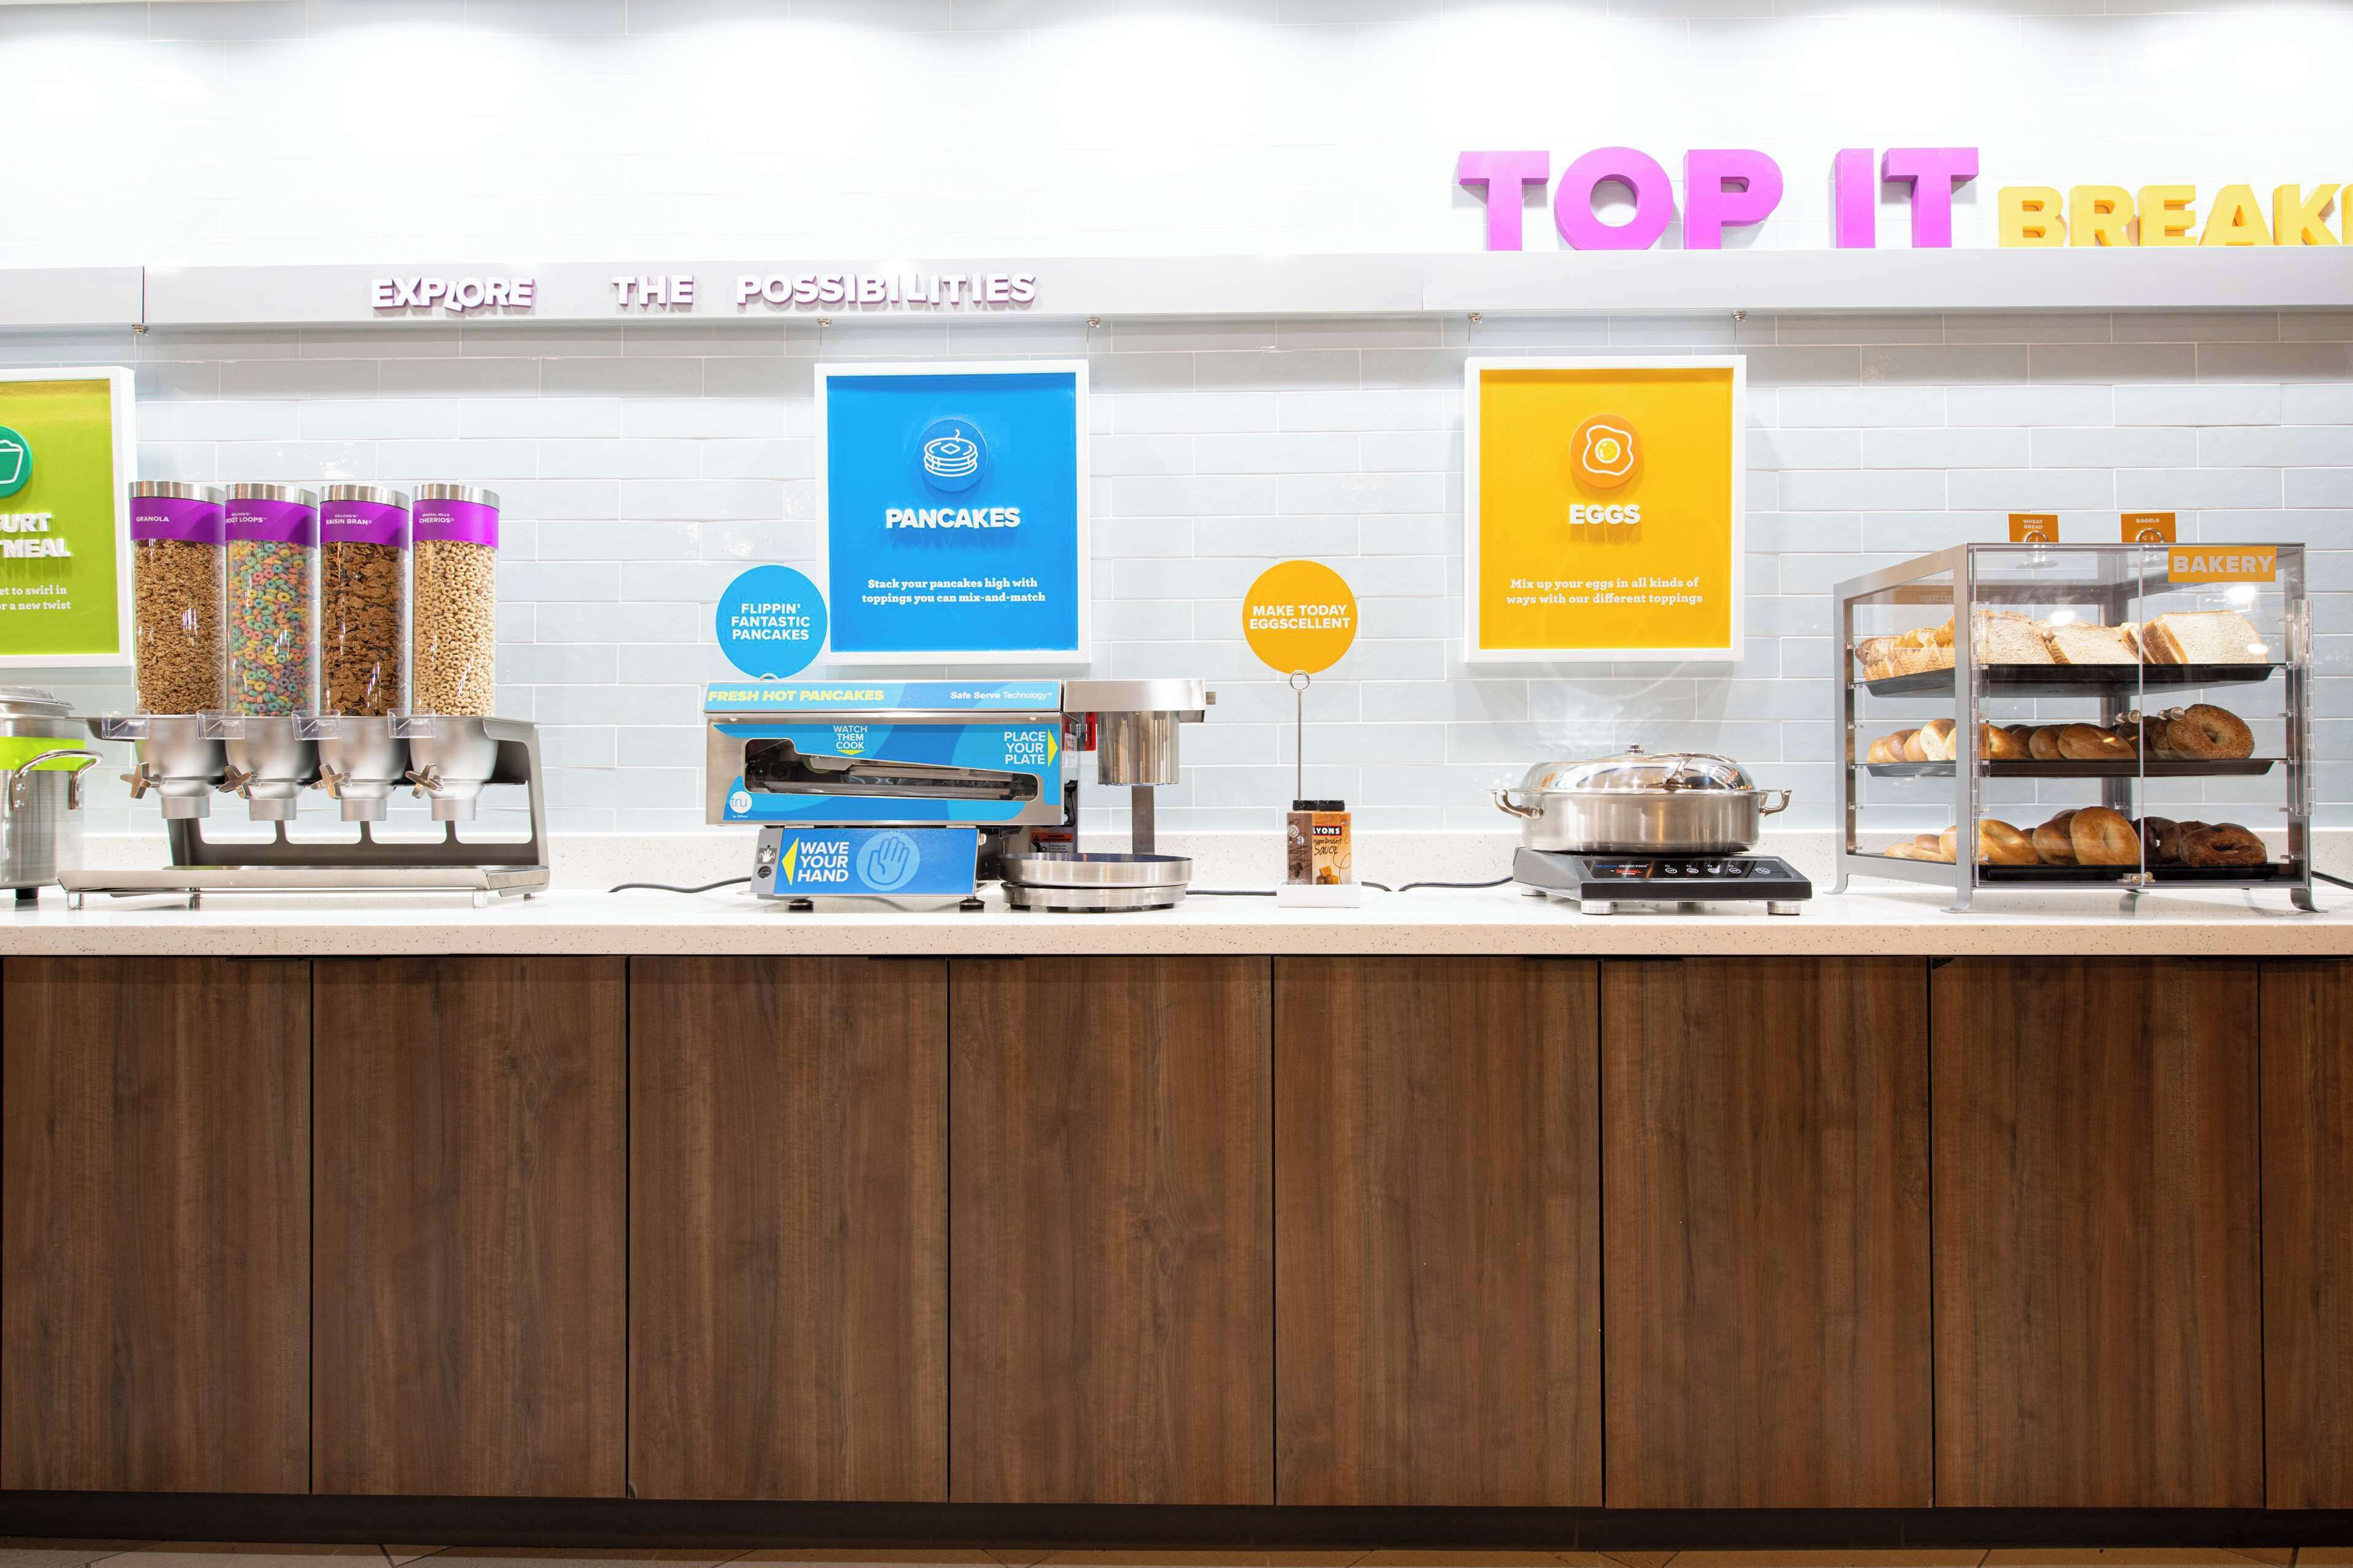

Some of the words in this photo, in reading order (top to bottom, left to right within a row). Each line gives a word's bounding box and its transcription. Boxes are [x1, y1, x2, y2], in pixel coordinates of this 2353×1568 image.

[1458, 145, 1784, 251] TOP
[1834, 147, 1979, 249] IT
[370, 276, 536, 312] EXPLORE
[612, 275, 695, 308] THE
[737, 272, 1038, 306] POSSIBILITIES
[886, 507, 1021, 529] PANCAKES
[1569, 504, 1641, 525] EGGS
[0, 513, 52, 532] URT
[0, 539, 71, 558] MEAL
[2173, 555, 2273, 573] BAKERY
[25, 584, 53, 595] swirl
[56, 584, 67, 595] in
[867, 578, 899, 588] Stack
[901, 581, 927, 591] your
[929, 578, 983, 591] pancakes
[984, 578, 1010, 589] high
[1011, 578, 1038, 588] with
[1510, 579, 1534, 588] Mix
[1537, 582, 1552, 591] up
[1554, 581, 1583, 591] your
[1586, 581, 1613, 590] eggs
[1616, 578, 1629, 588] in
[1632, 578, 1646, 588] all
[1649, 577, 1683, 588] kinds
[1686, 577, 1700, 588] of
[43, 599, 72, 610] twist
[862, 593, 912, 605] toppings
[914, 595, 935, 605] you
[959, 592, 1046, 602] mix-and-match
[1506, 595, 1536, 606] ways
[1538, 594, 1566, 604] with
[1593, 593, 1646, 603] different
[1649, 593, 1703, 605] toppings
[741, 603, 800, 614] FLIPPIN'
[1253, 605, 1294, 616] MAKE
[1298, 604, 1347, 616] TODAY
[731, 616, 810, 627] FANTASTIC
[1250, 618, 1350, 630] EGGSCELLENT
[732, 629, 810, 640] PANCAKES
[708, 691, 759, 701] FRESH
[762, 691, 796, 701] HOT
[800, 690, 884, 701] PANCAKES
[833, 725, 867, 733] WATCH
[1004, 731, 1046, 743] PLACE
[1006, 743, 1044, 754] YOUR
[1005, 754, 1045, 765] PLATE
[730, 797, 747, 807] tru
[800, 841, 850, 854] WAVE
[1313, 843, 1339, 855] Sauce
[800, 855, 848, 868] YOUR
[797, 869, 849, 882] HAND
